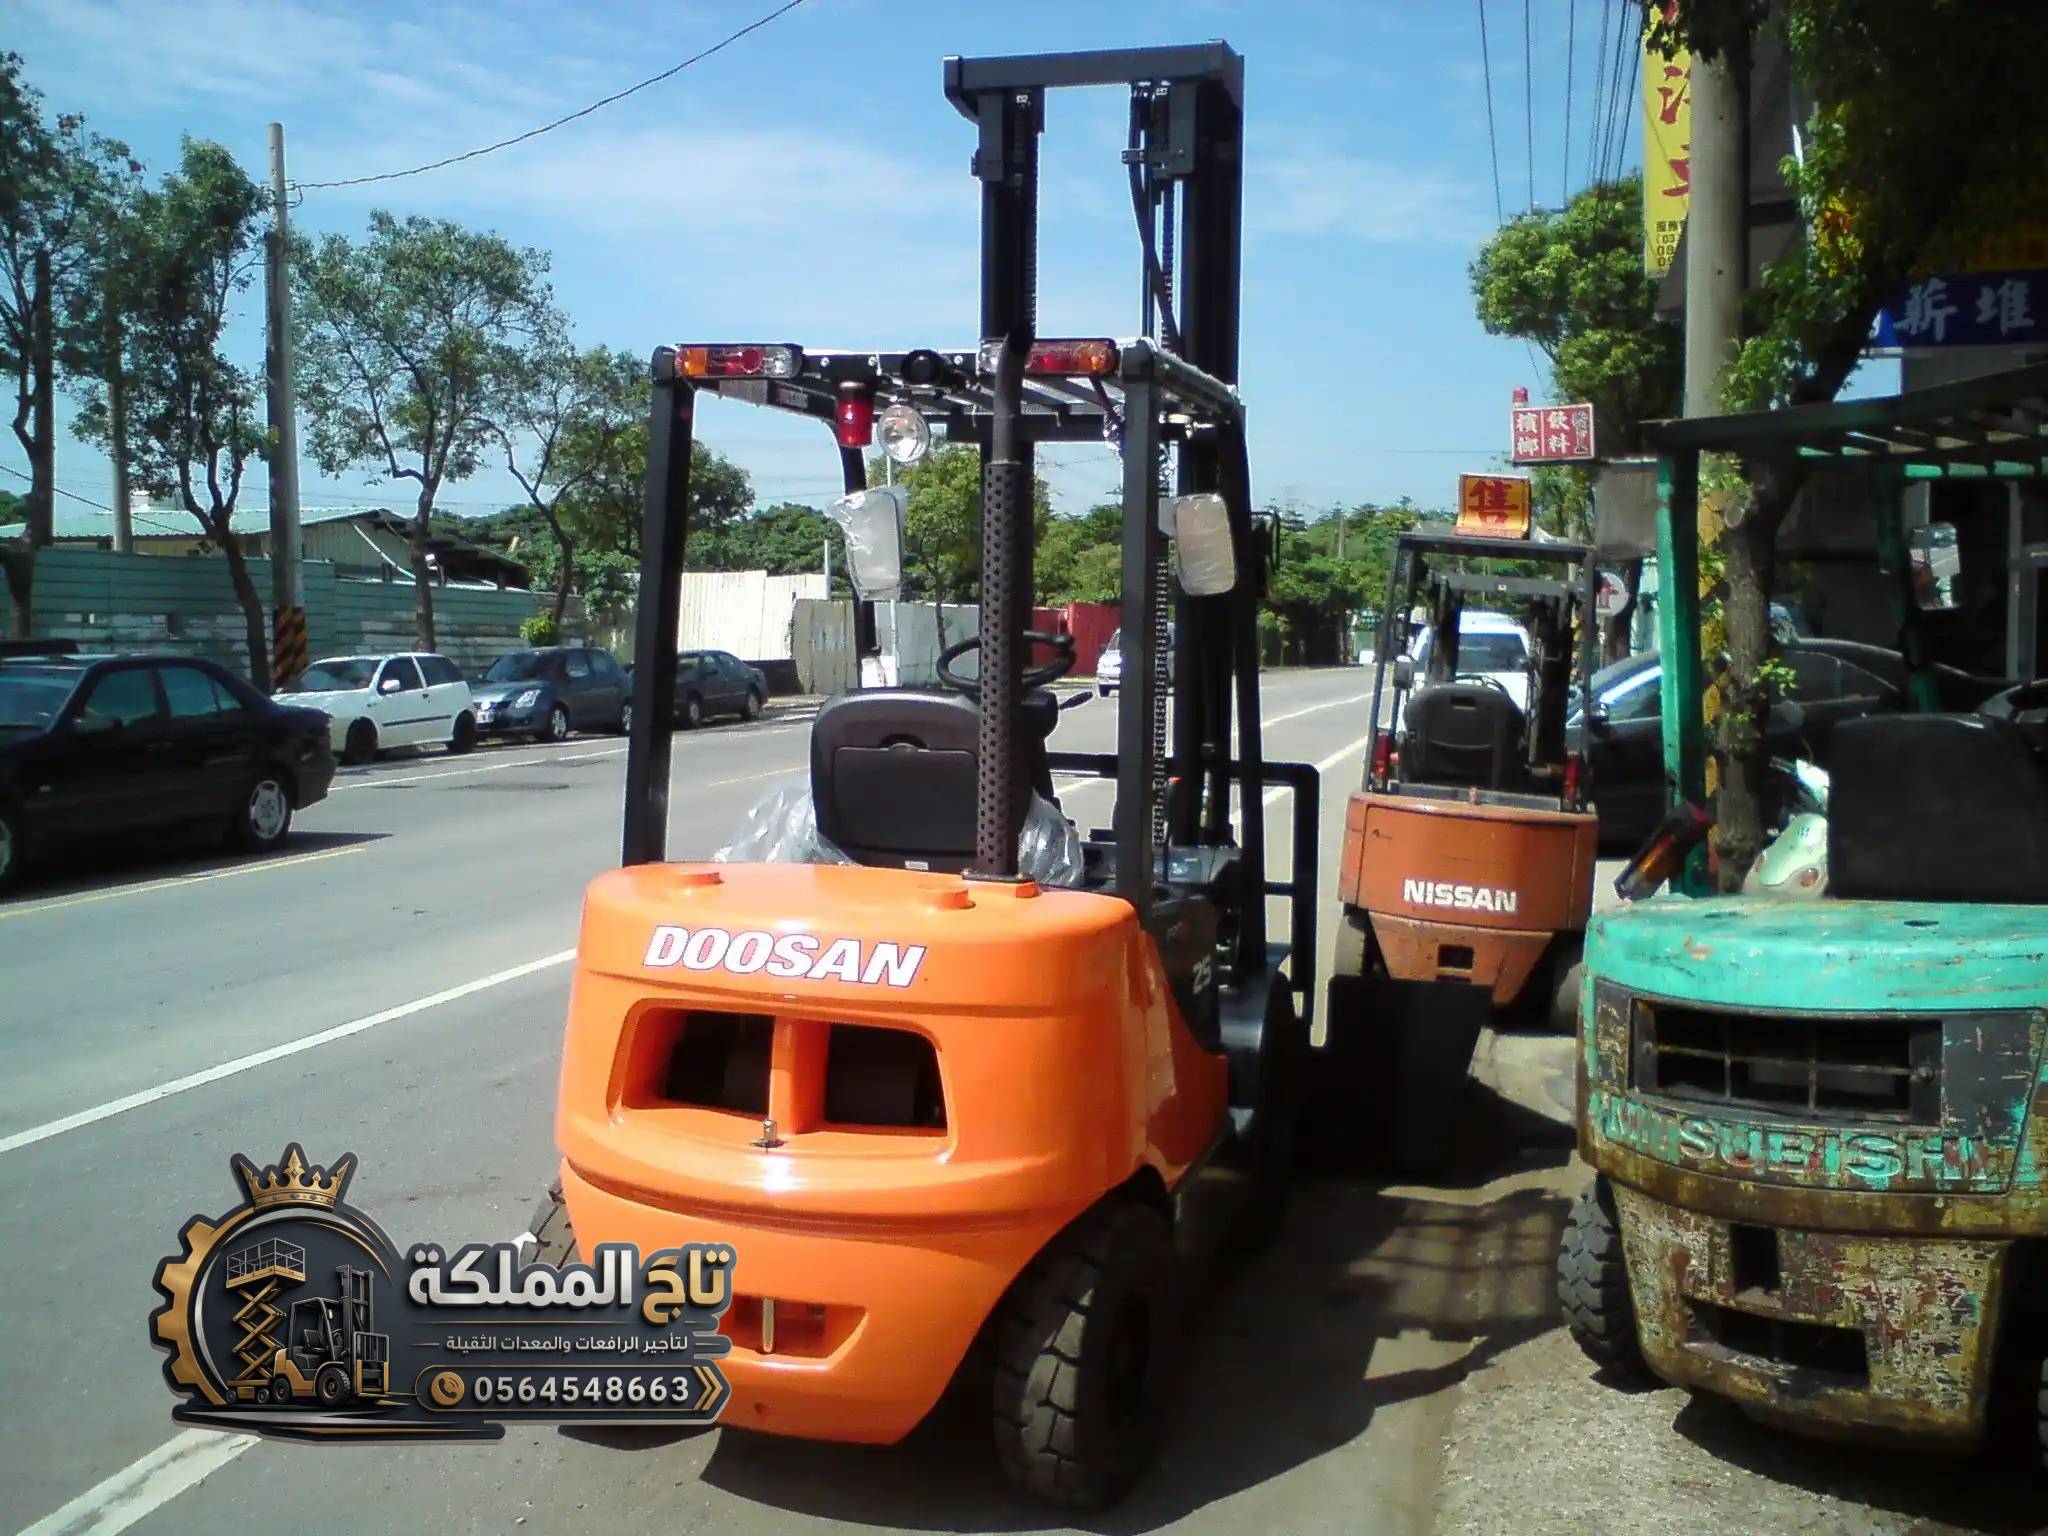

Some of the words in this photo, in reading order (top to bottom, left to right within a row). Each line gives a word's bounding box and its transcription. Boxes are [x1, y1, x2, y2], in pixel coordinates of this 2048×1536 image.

[1467, 479, 1519, 525] 售
[1403, 878, 1519, 913] NISSAN
[642, 924, 928, 988] DOOSAN
